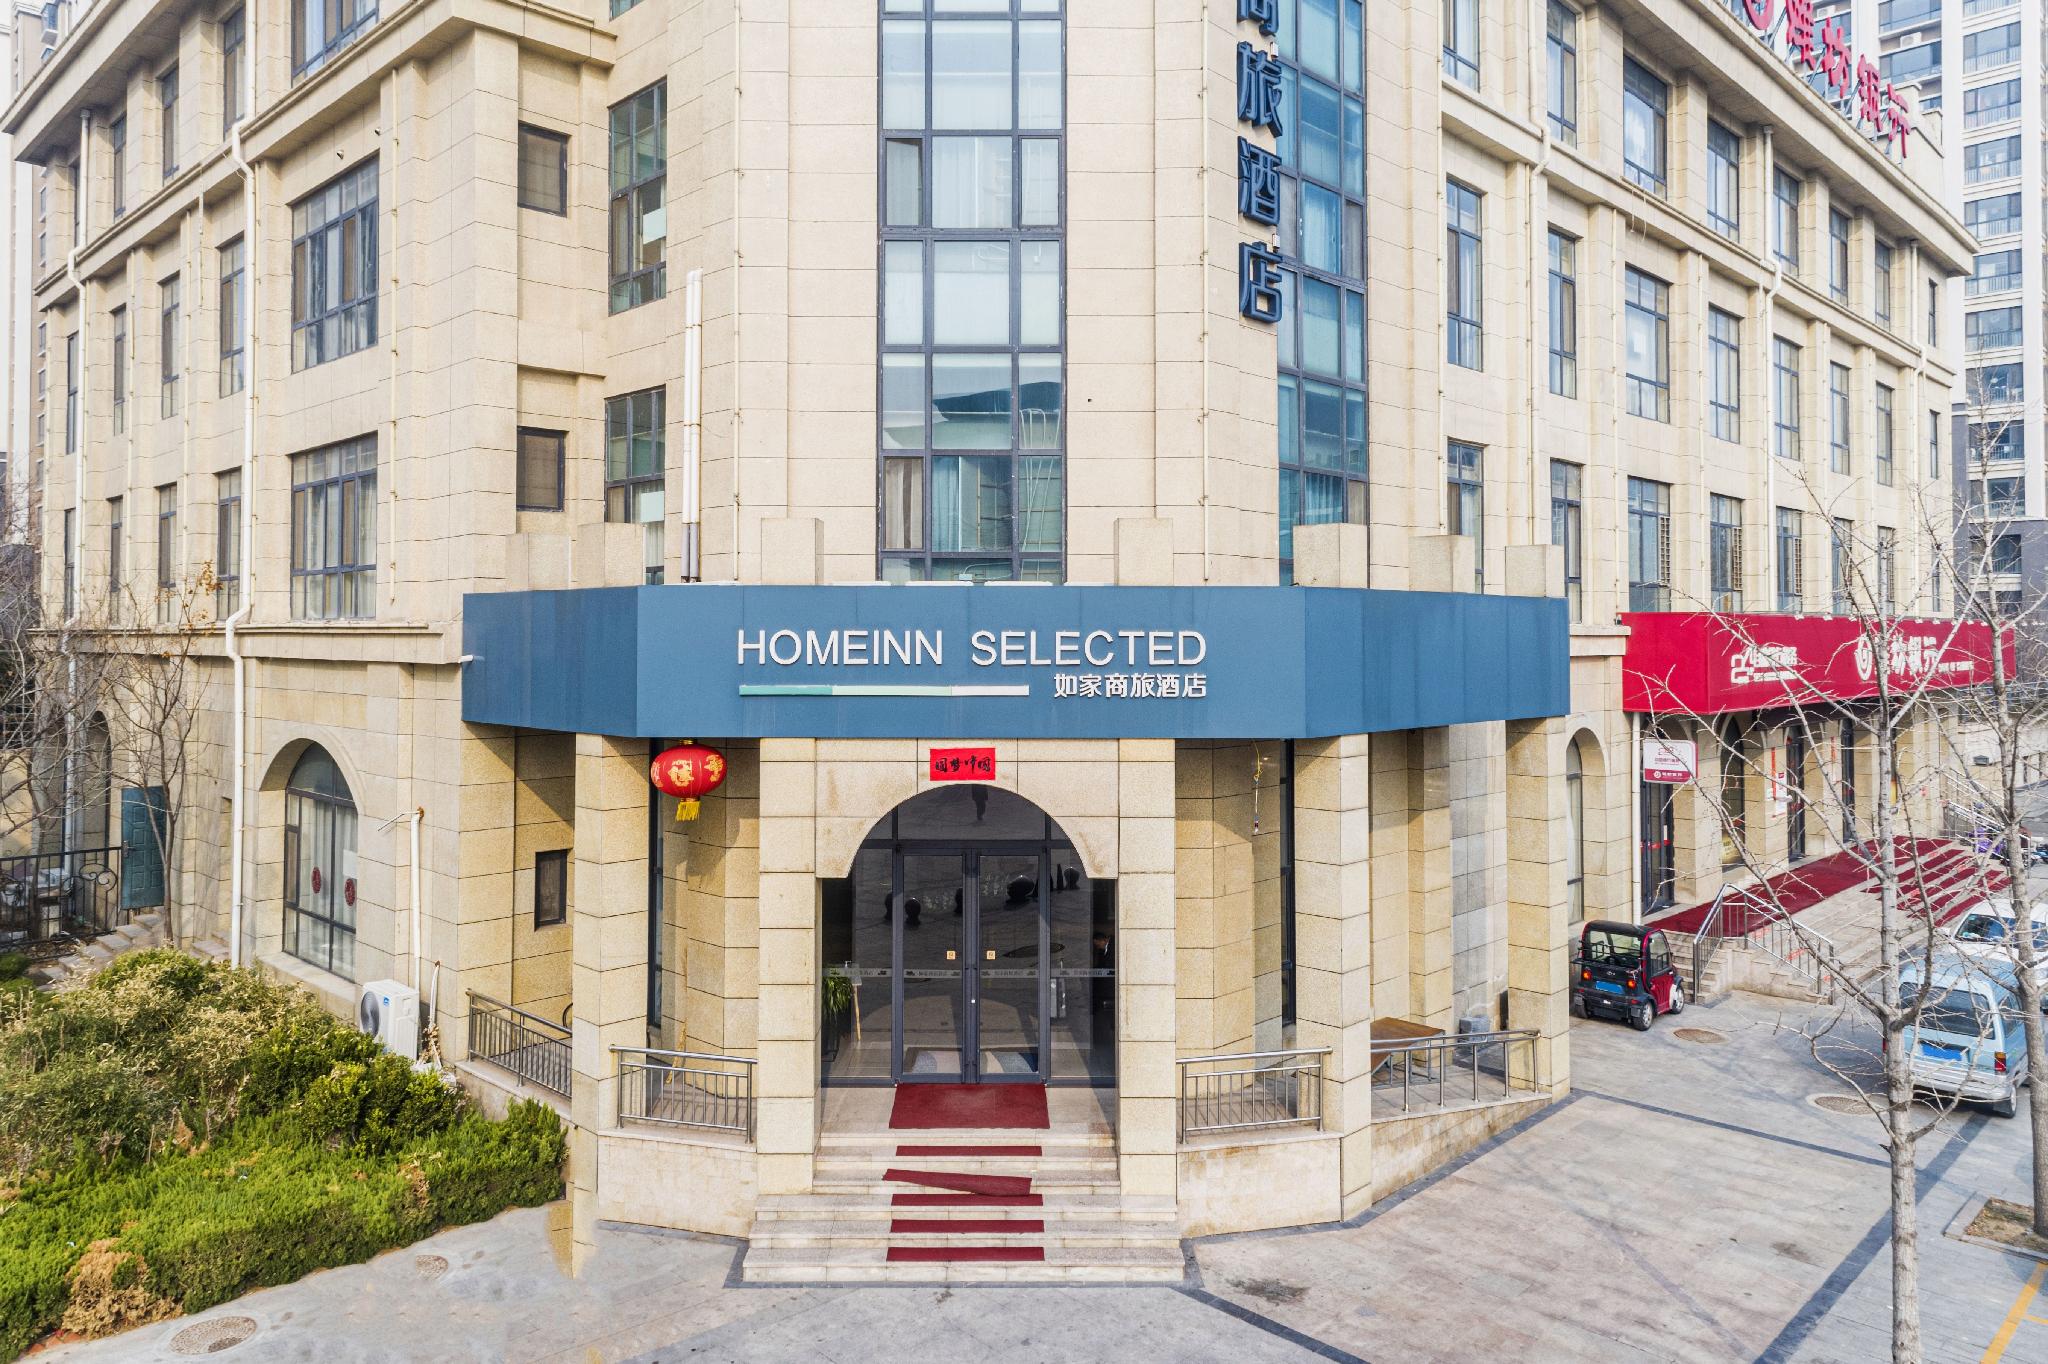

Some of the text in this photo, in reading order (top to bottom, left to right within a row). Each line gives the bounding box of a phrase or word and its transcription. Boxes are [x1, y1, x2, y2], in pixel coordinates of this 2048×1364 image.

[737, 629, 1207, 668] HOMEINN SELECTED
[1053, 672, 1207, 699] 如家商旅酒店
